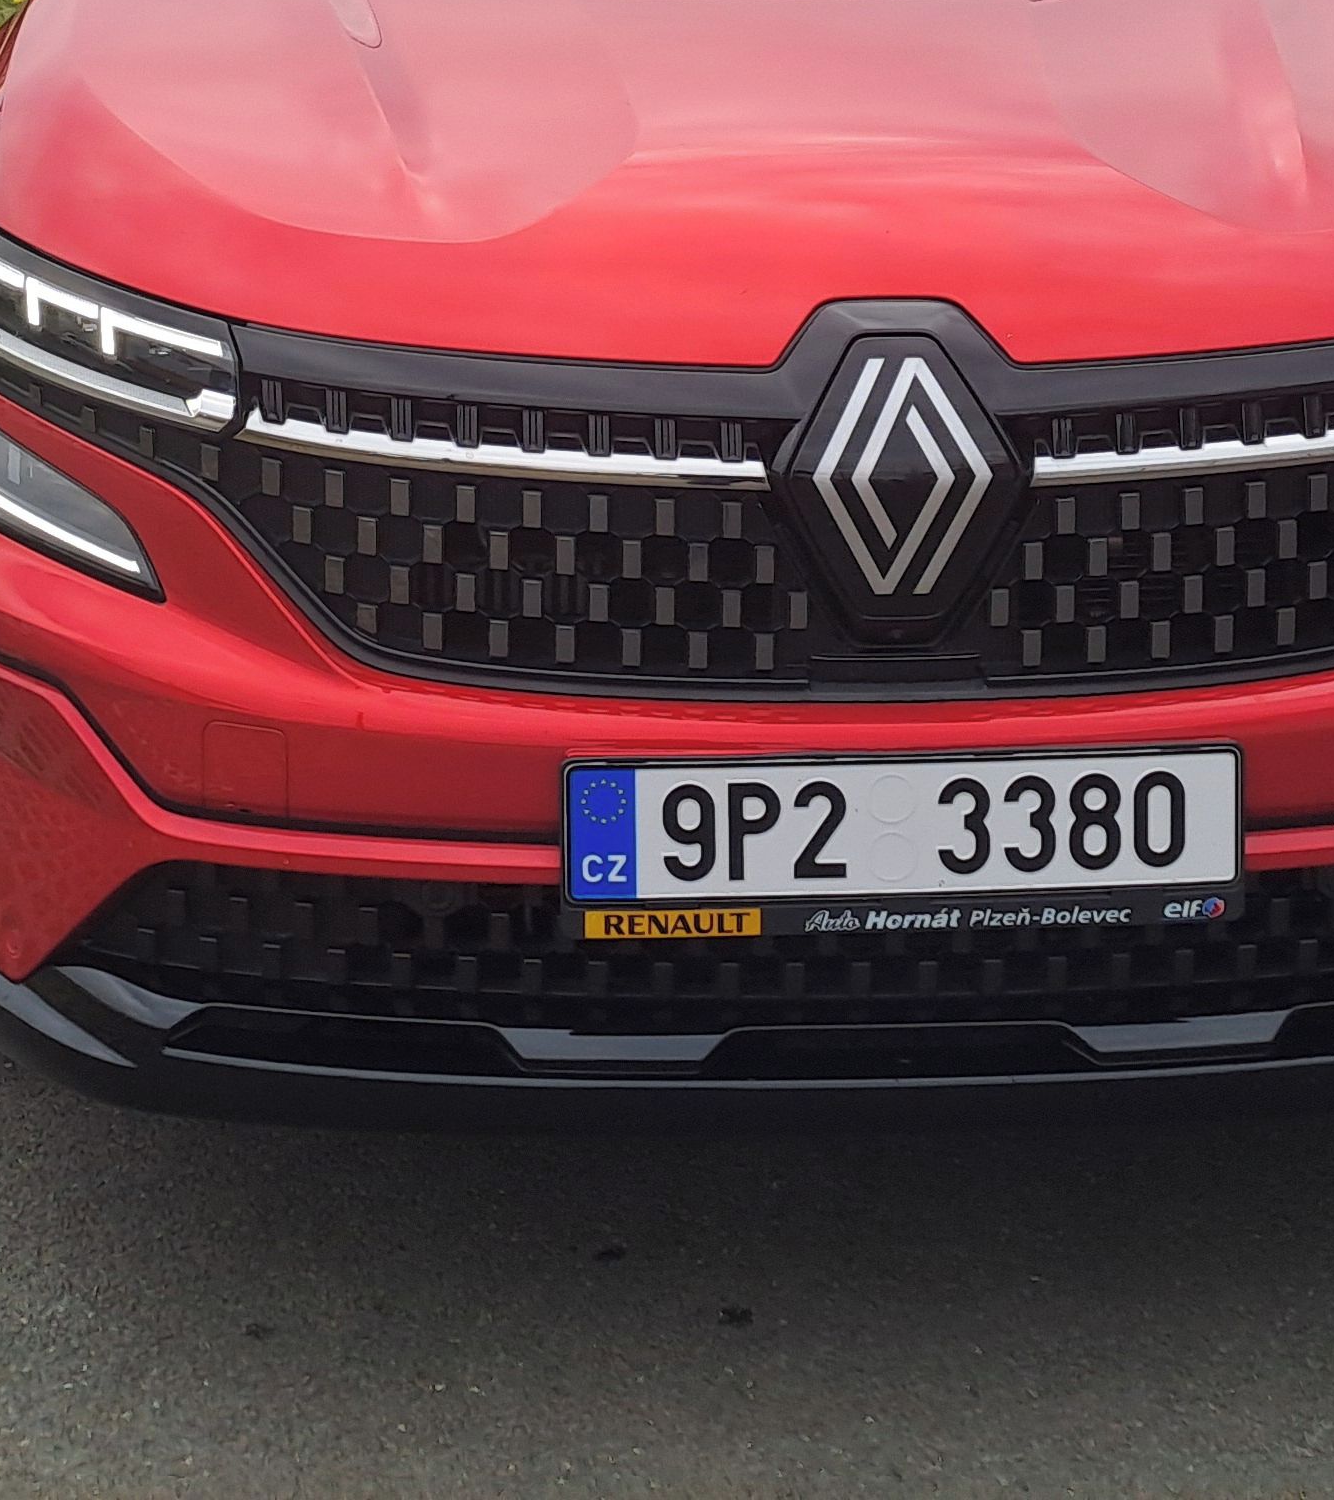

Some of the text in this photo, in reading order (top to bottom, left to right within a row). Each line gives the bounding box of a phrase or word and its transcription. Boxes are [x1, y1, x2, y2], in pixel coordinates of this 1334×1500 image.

[662, 770, 1186, 882] 9P2 3380
[581, 854, 628, 883] CZ
[805, 906, 1132, 932] Auto Hornát Plzeň-Bolevec
[1163, 900, 1203, 918] elf
[603, 912, 751, 936] RENAULT
